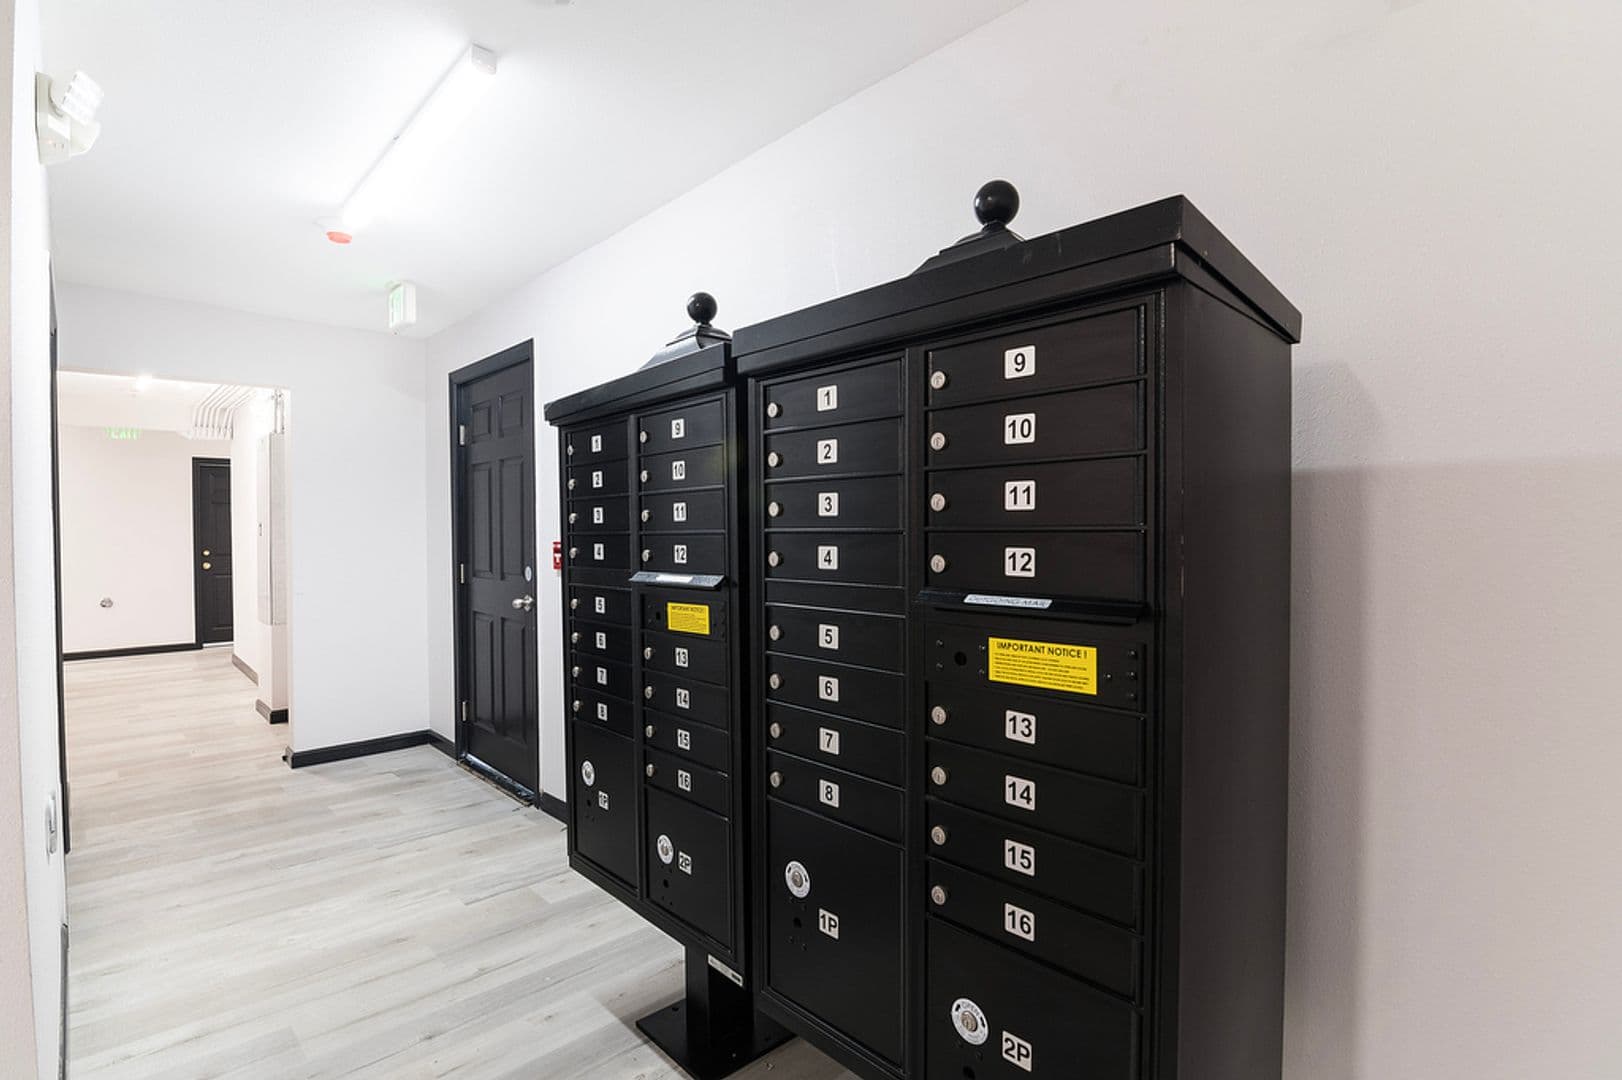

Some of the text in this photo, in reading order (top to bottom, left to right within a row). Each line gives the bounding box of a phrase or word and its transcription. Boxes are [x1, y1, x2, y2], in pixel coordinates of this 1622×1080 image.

[1014, 352, 1026, 373] 9
[824, 391, 830, 405] 1
[1008, 418, 1032, 439] 10
[824, 443, 832, 459] 2
[824, 496, 832, 513] 3
[1009, 485, 1031, 505] 11
[823, 550, 832, 566] 4
[1008, 552, 1032, 572] 12
[824, 628, 833, 645] 5
[996, 641, 1046, 654] IMPORTANT
[1047, 646, 1081, 658] NOTICE
[824, 680, 833, 697] 6
[1008, 715, 1032, 738] 13
[825, 732, 834, 749] 7
[824, 784, 834, 802] 8
[1008, 781, 1033, 806] 14
[1007, 845, 1032, 870] 15
[820, 913, 838, 933] 1P
[1007, 909, 1032, 935] 16
[1004, 1037, 1030, 1062] 2P
